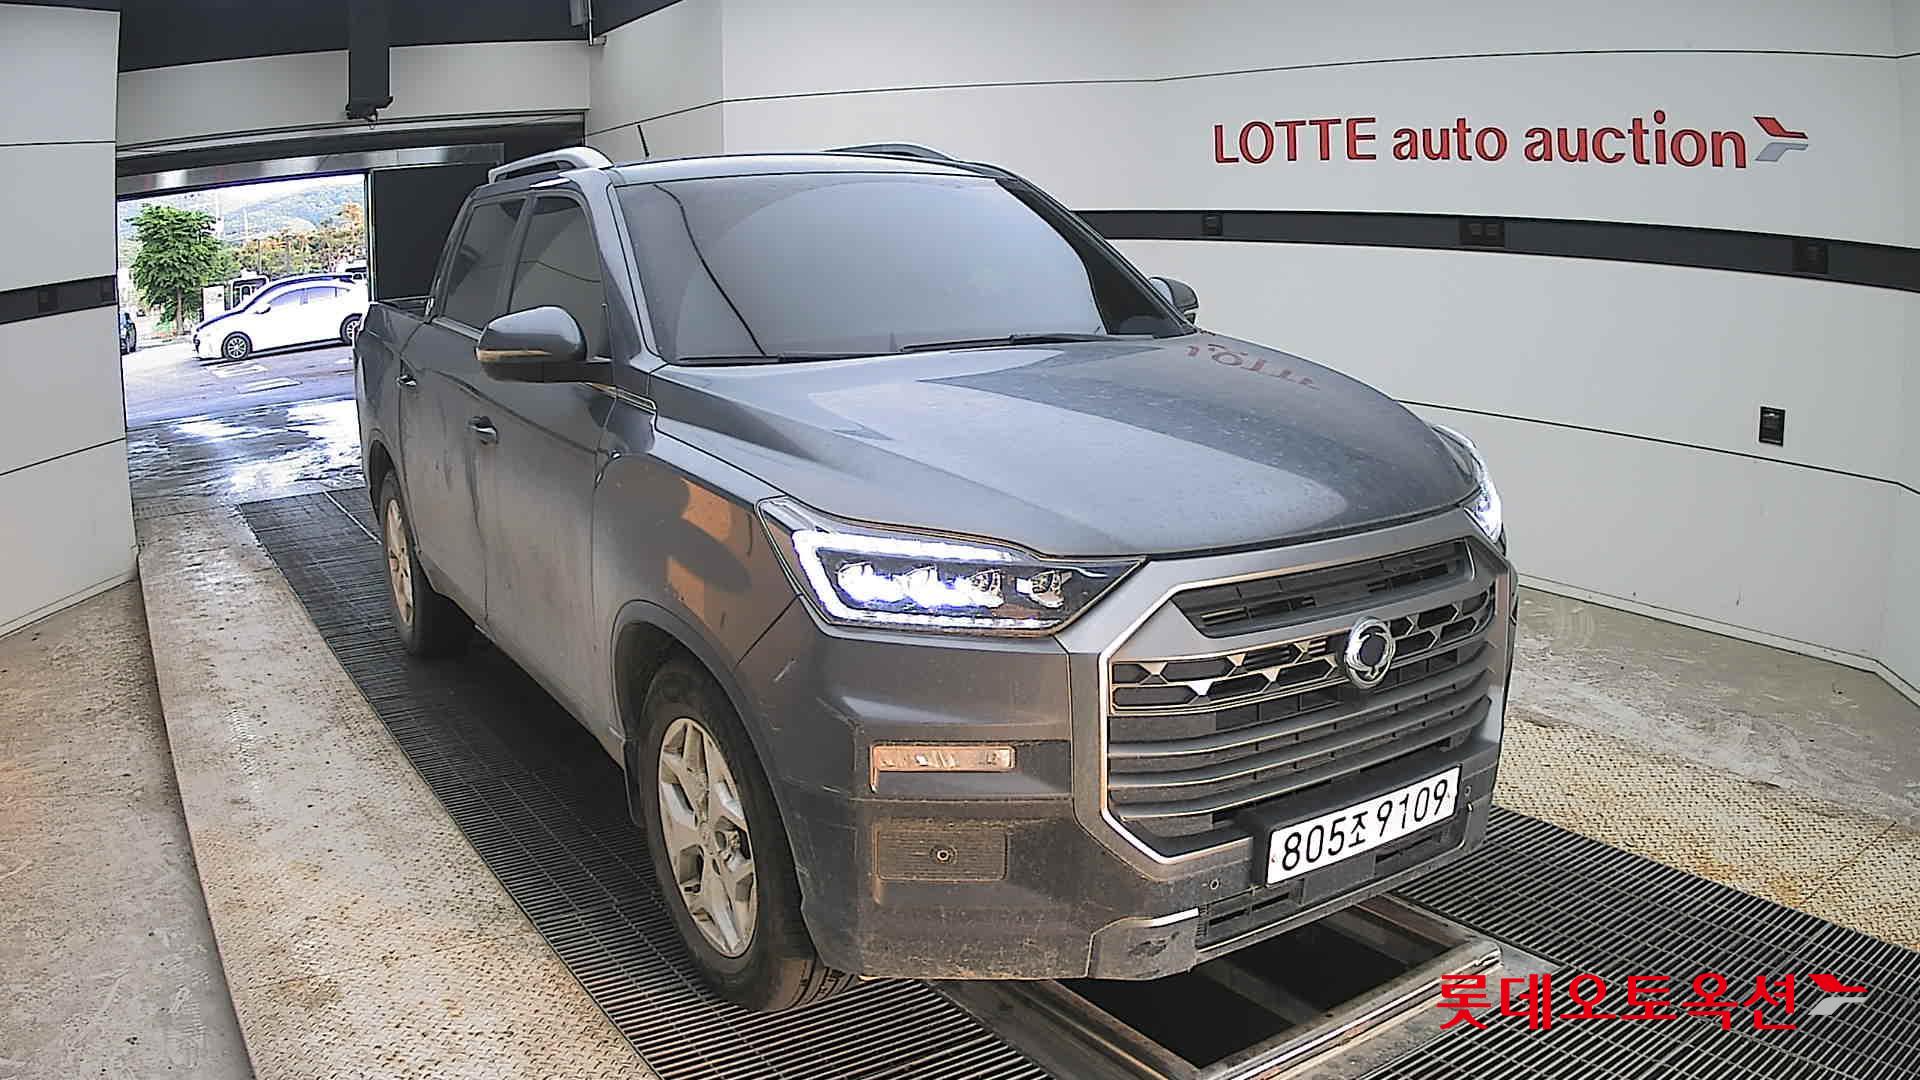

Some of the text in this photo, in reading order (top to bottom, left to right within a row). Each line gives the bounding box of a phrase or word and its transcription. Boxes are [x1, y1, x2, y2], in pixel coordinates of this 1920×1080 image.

[1214, 110, 1747, 169] LOTTE auto auction
[1376, 778, 1449, 837] 9109
